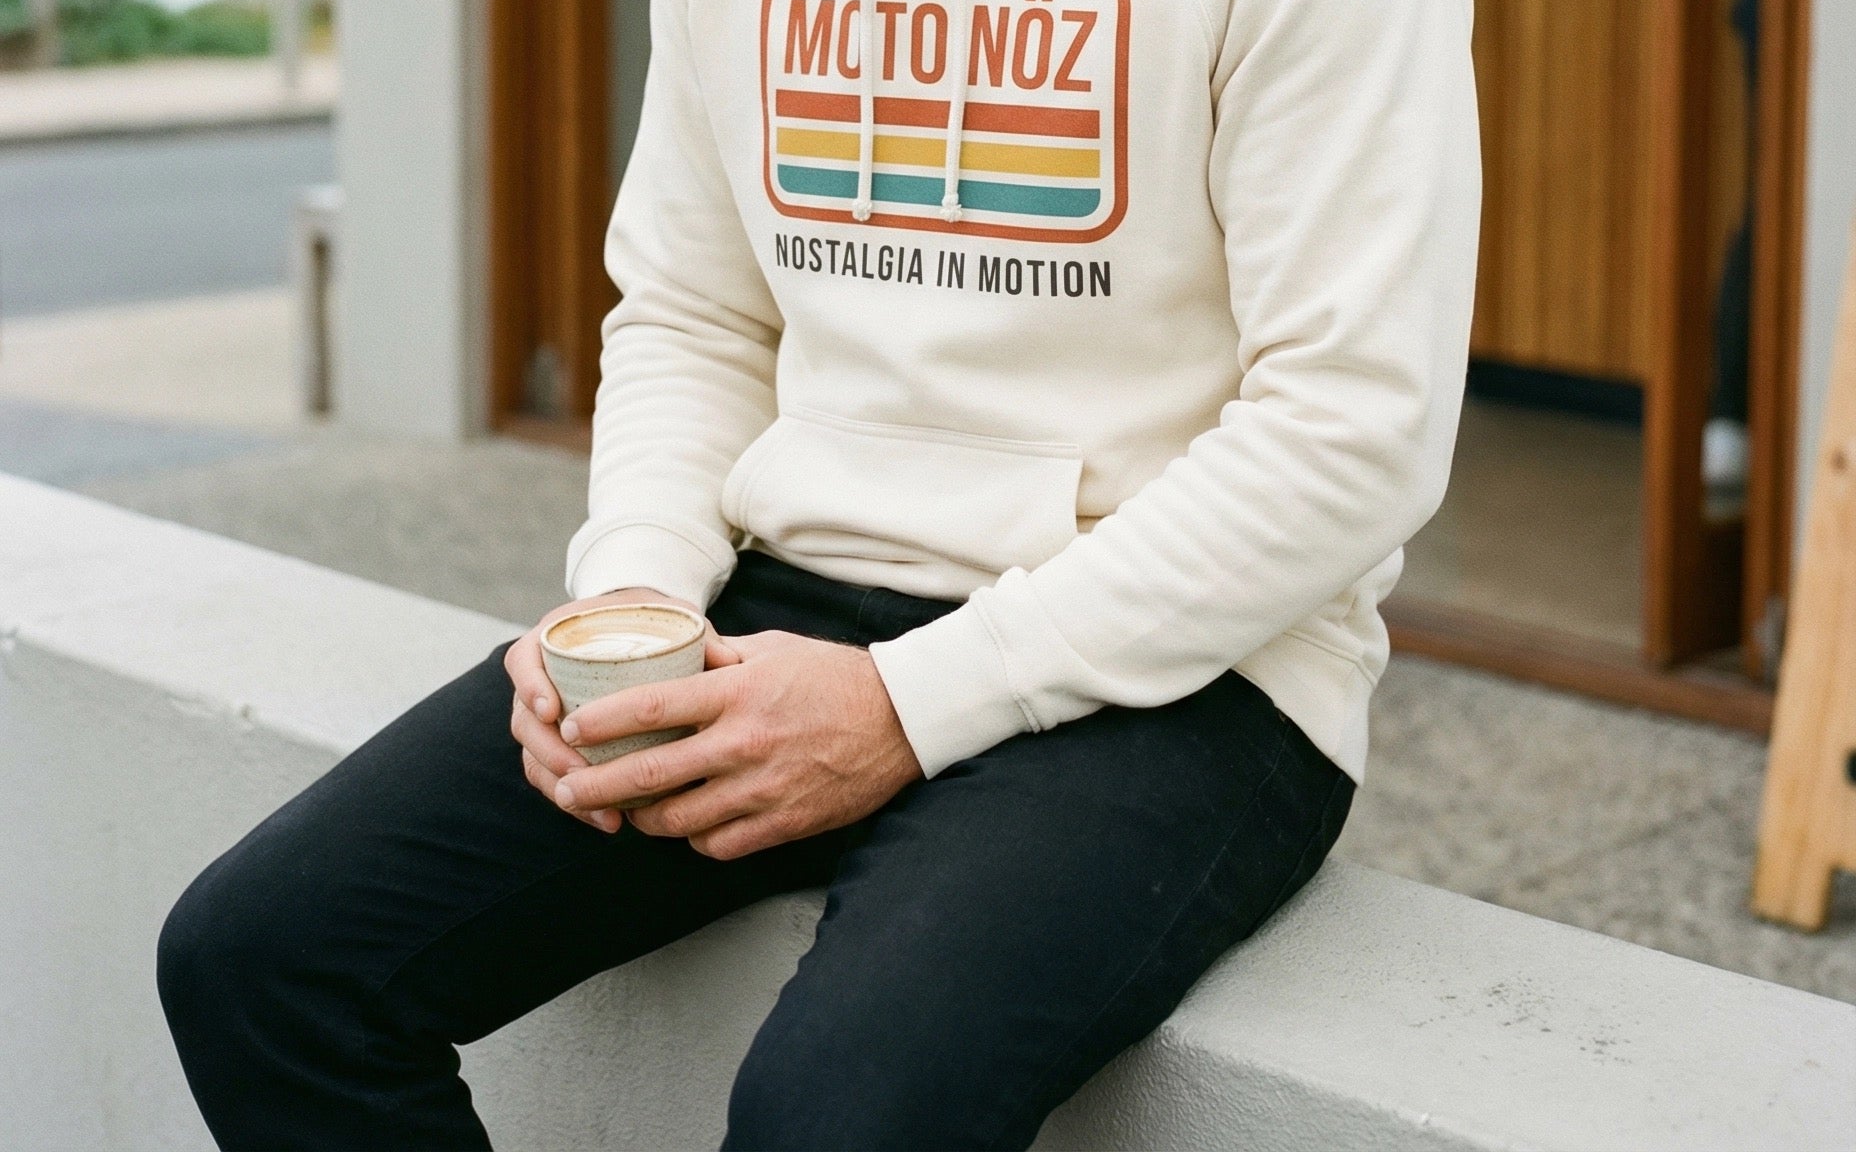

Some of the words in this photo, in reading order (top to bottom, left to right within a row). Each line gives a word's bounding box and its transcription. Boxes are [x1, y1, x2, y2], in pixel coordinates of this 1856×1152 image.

[775, 232, 924, 285] NOSTALGIA
[936, 250, 966, 290] IN
[978, 254, 1112, 298] MOTION
